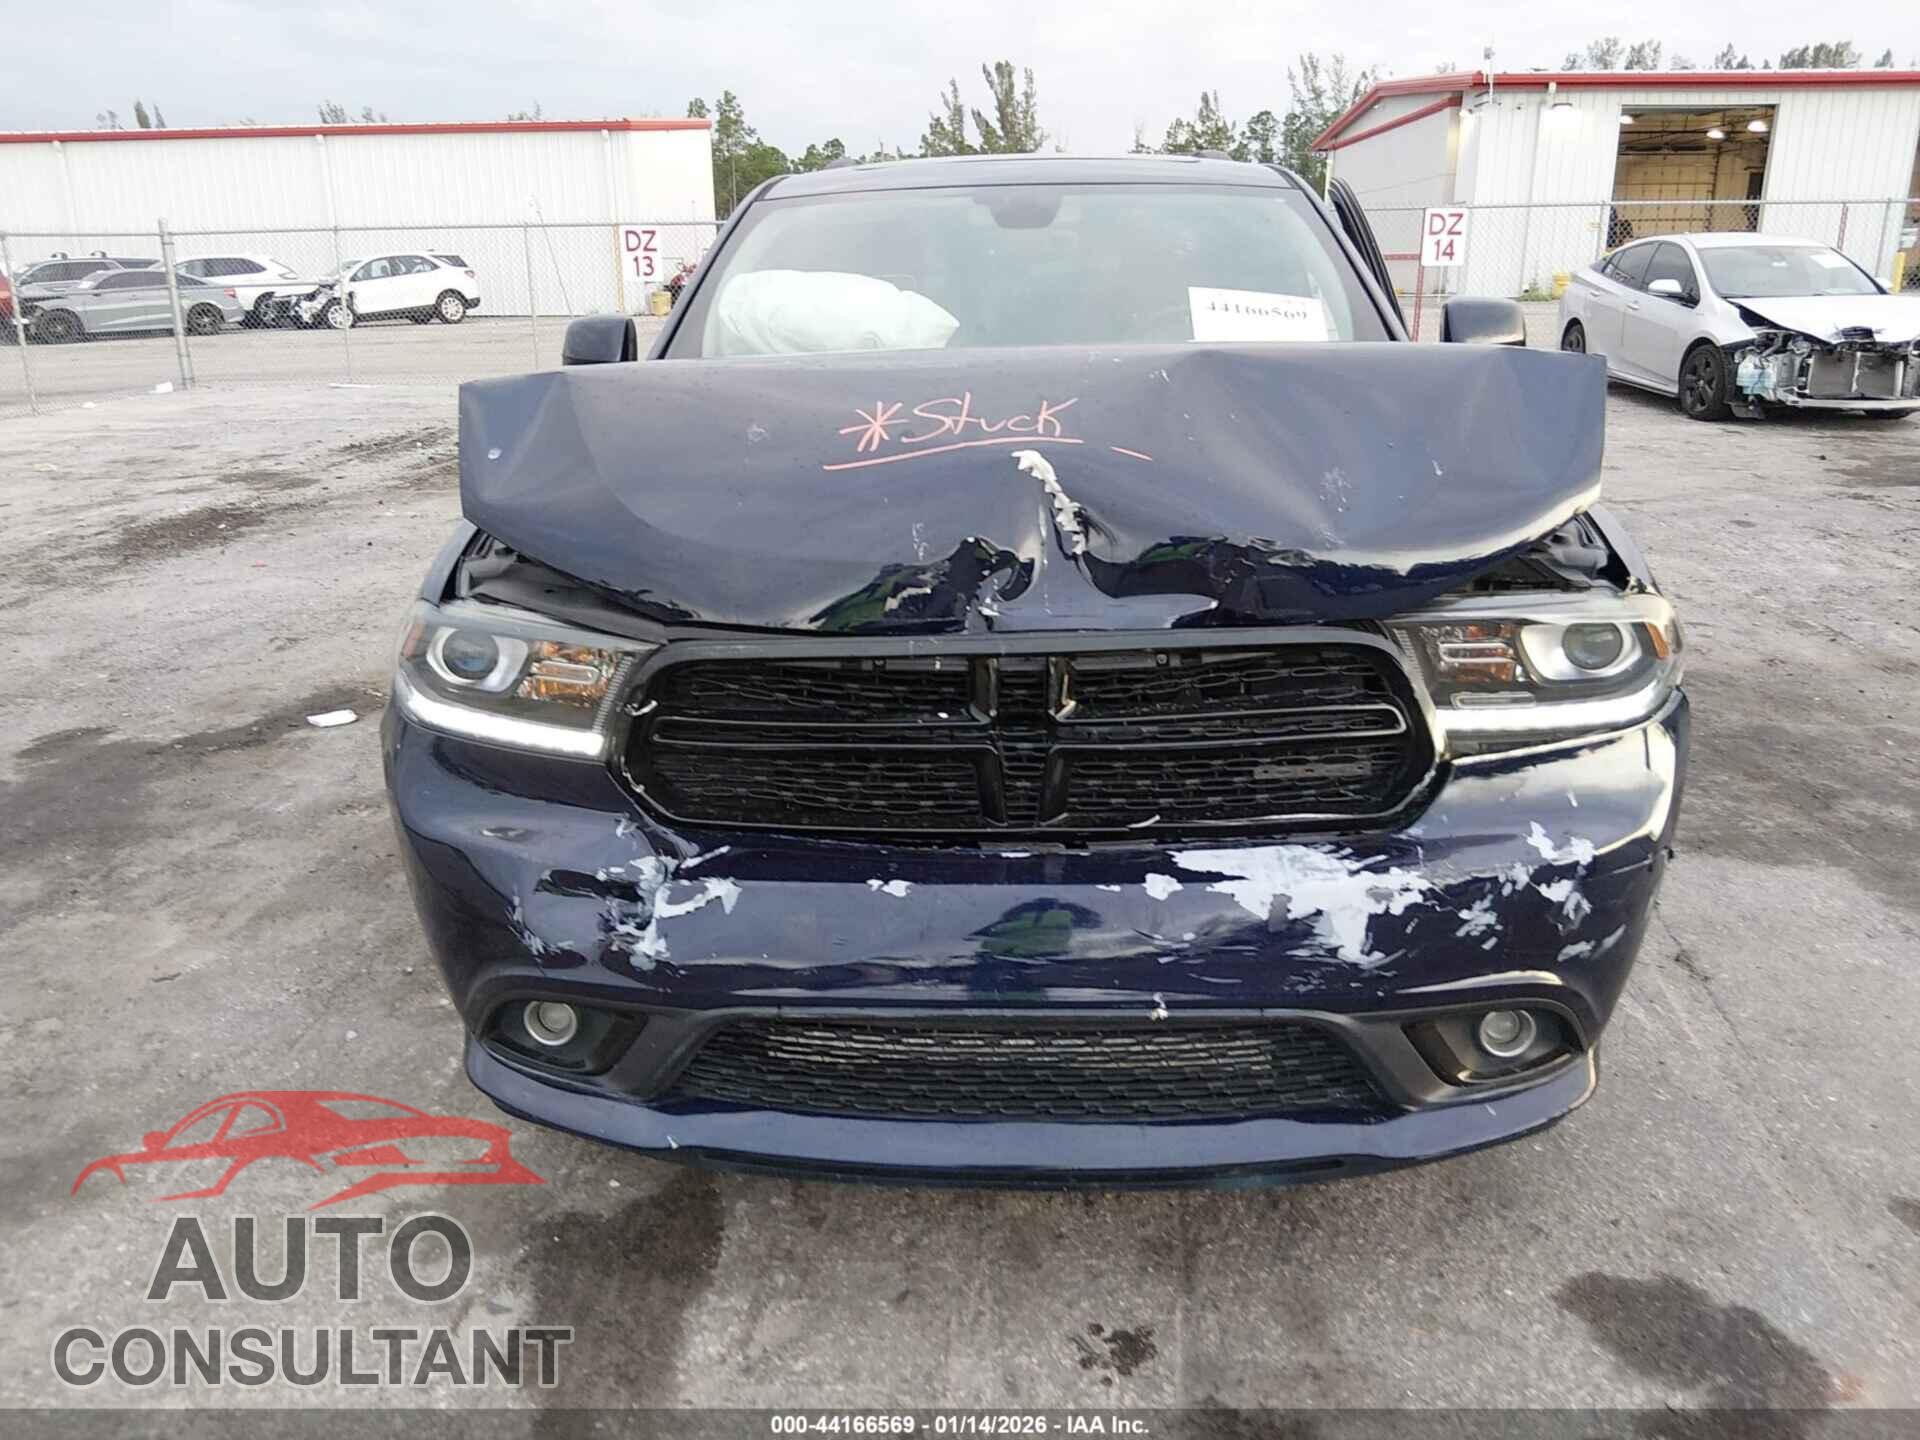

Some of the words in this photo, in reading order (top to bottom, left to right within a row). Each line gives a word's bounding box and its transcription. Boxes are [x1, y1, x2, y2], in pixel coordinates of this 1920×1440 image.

[1428, 212, 1464, 236] DZ
[624, 229, 658, 252] DZ
[1434, 239, 1455, 261] 14
[632, 255, 655, 277] 13
